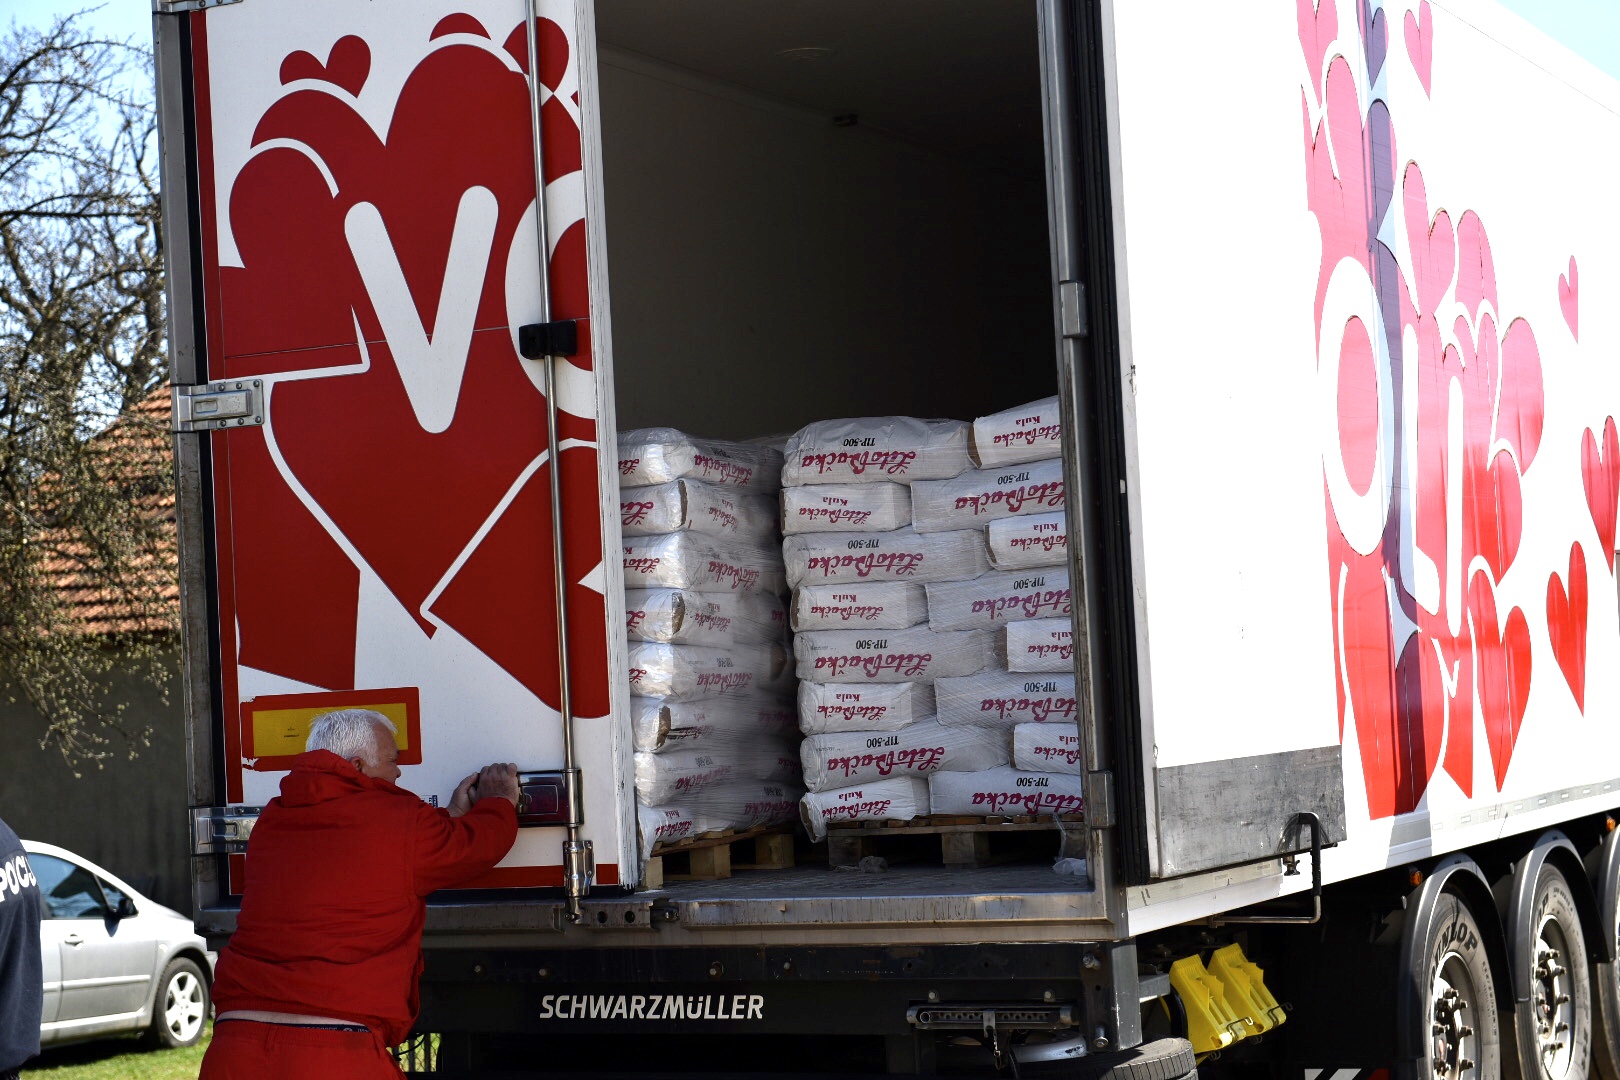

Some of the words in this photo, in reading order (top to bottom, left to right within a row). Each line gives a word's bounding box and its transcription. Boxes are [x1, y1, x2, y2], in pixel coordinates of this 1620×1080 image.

[1016, 415, 1041, 427] Kula
[843, 437, 876, 447] TIP-500
[997, 471, 1030, 485] TIP-500
[823, 496, 848, 506] Kula
[1033, 522, 1059, 533] Kula
[847, 538, 880, 550] TIP-500
[1014, 576, 1045, 590] TIP-500
[832, 594, 857, 603] Kula
[856, 639, 888, 650] TIP-500
[1024, 681, 1057, 693] TIP-500
[836, 693, 861, 702] Kula
[866, 735, 900, 748] TIP-500
[1016, 777, 1049, 787] TIP-500
[838, 790, 863, 801] Kula
[539, 994, 764, 1020] SCHWARZMÜLLER
